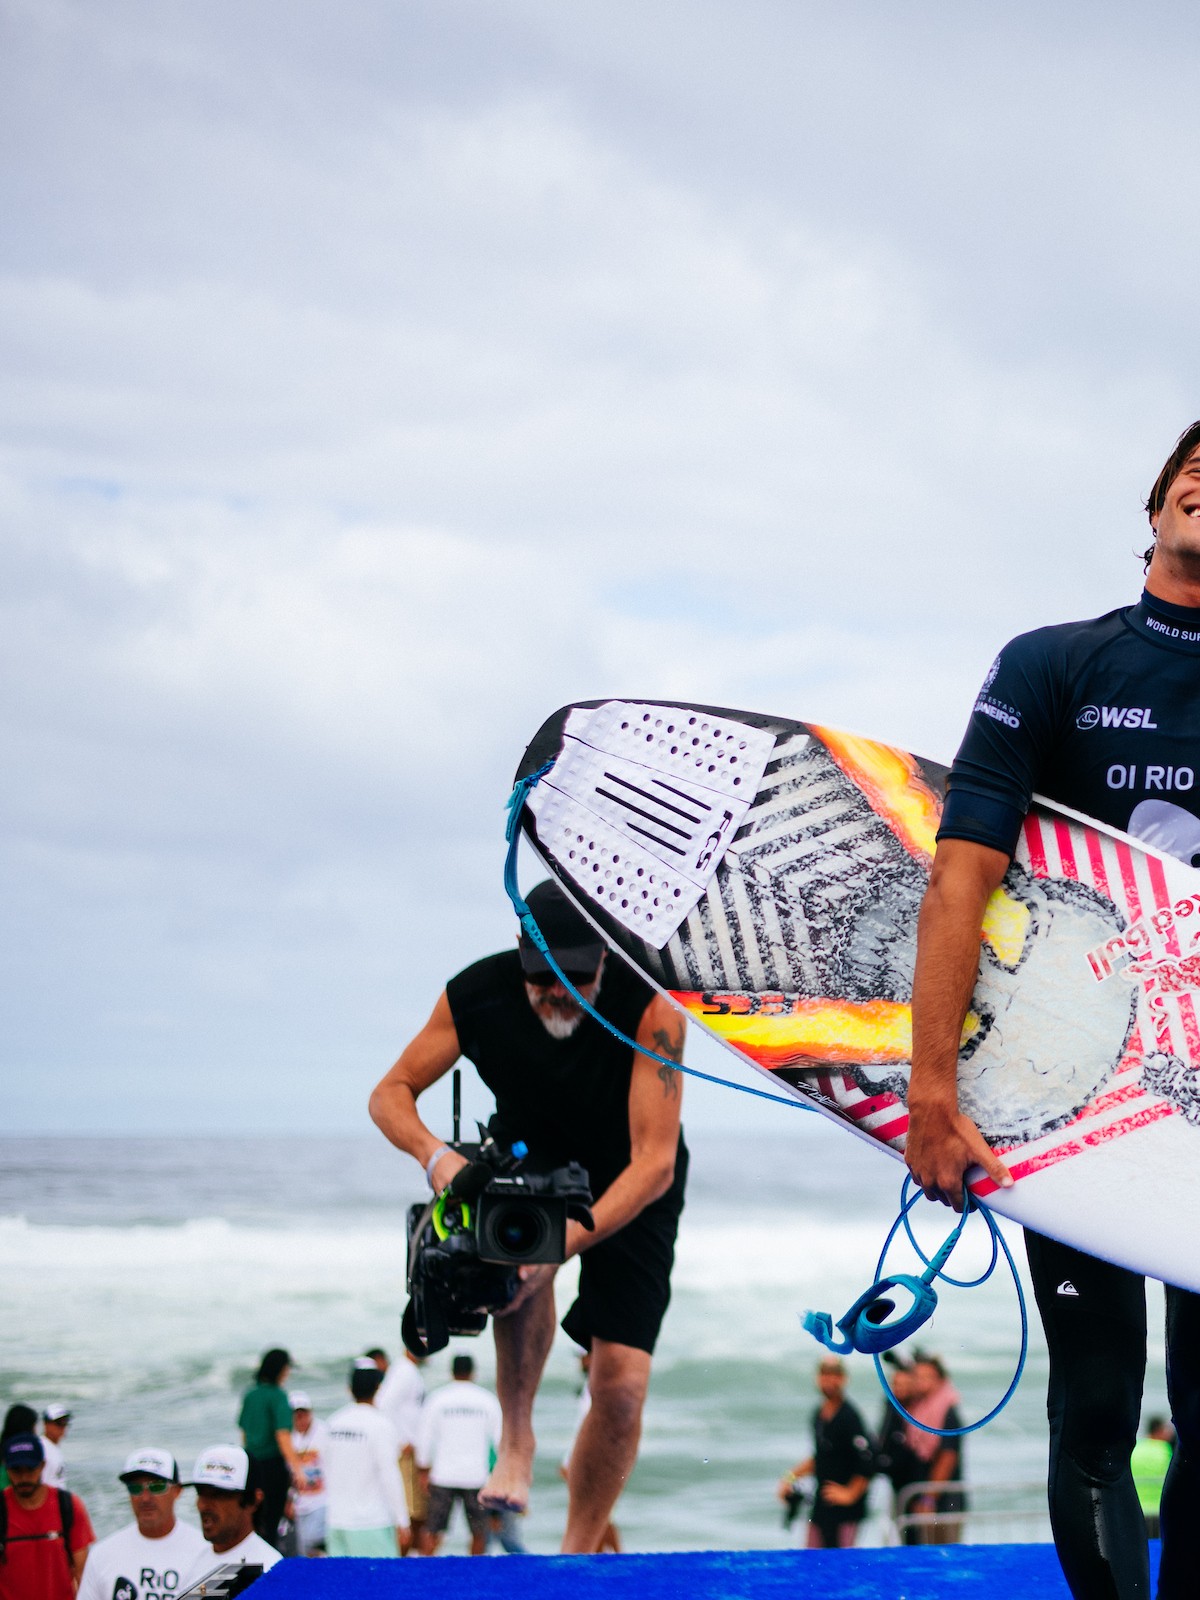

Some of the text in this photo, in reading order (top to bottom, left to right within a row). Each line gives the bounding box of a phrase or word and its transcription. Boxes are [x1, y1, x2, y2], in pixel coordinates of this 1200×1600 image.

[1146, 616, 1179, 638] WORLD
[988, 696, 1022, 717] ESTADO
[1101, 706, 1158, 729] WSL
[1106, 764, 1137, 789] OI
[1144, 765, 1195, 791] RIO
[696, 810, 733, 871] FCS
[1086, 922, 1150, 982] Bull
